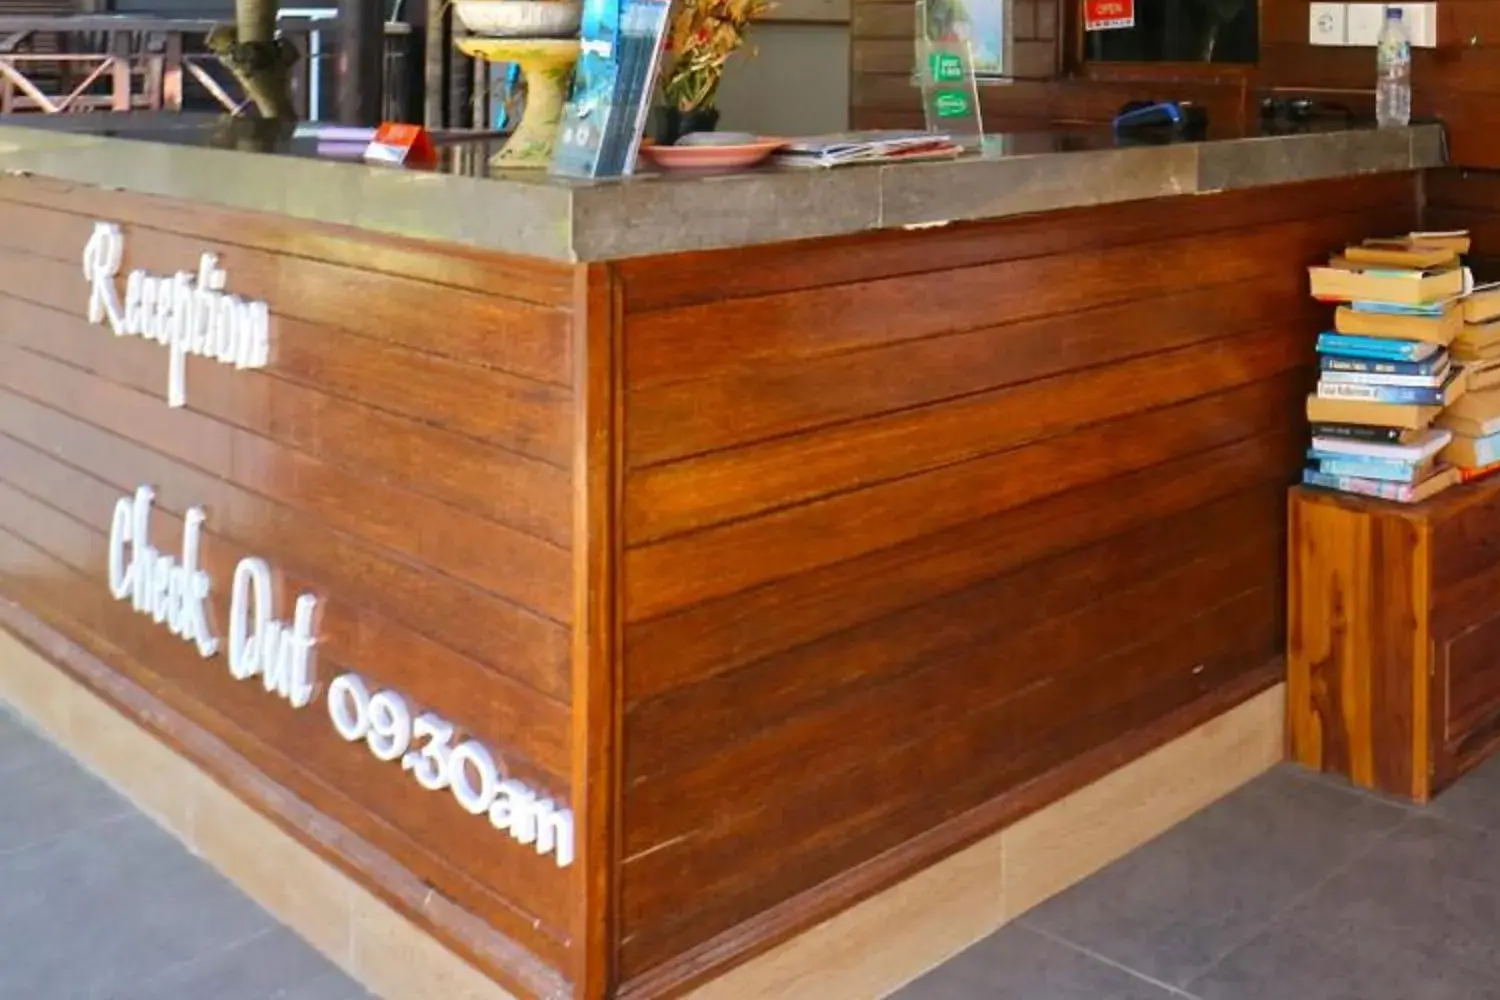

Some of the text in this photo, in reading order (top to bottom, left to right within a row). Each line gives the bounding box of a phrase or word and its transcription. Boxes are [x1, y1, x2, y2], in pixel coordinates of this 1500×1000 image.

[83, 222, 270, 408] Reception
[109, 484, 219, 657] Check
[227, 557, 318, 708] Out
